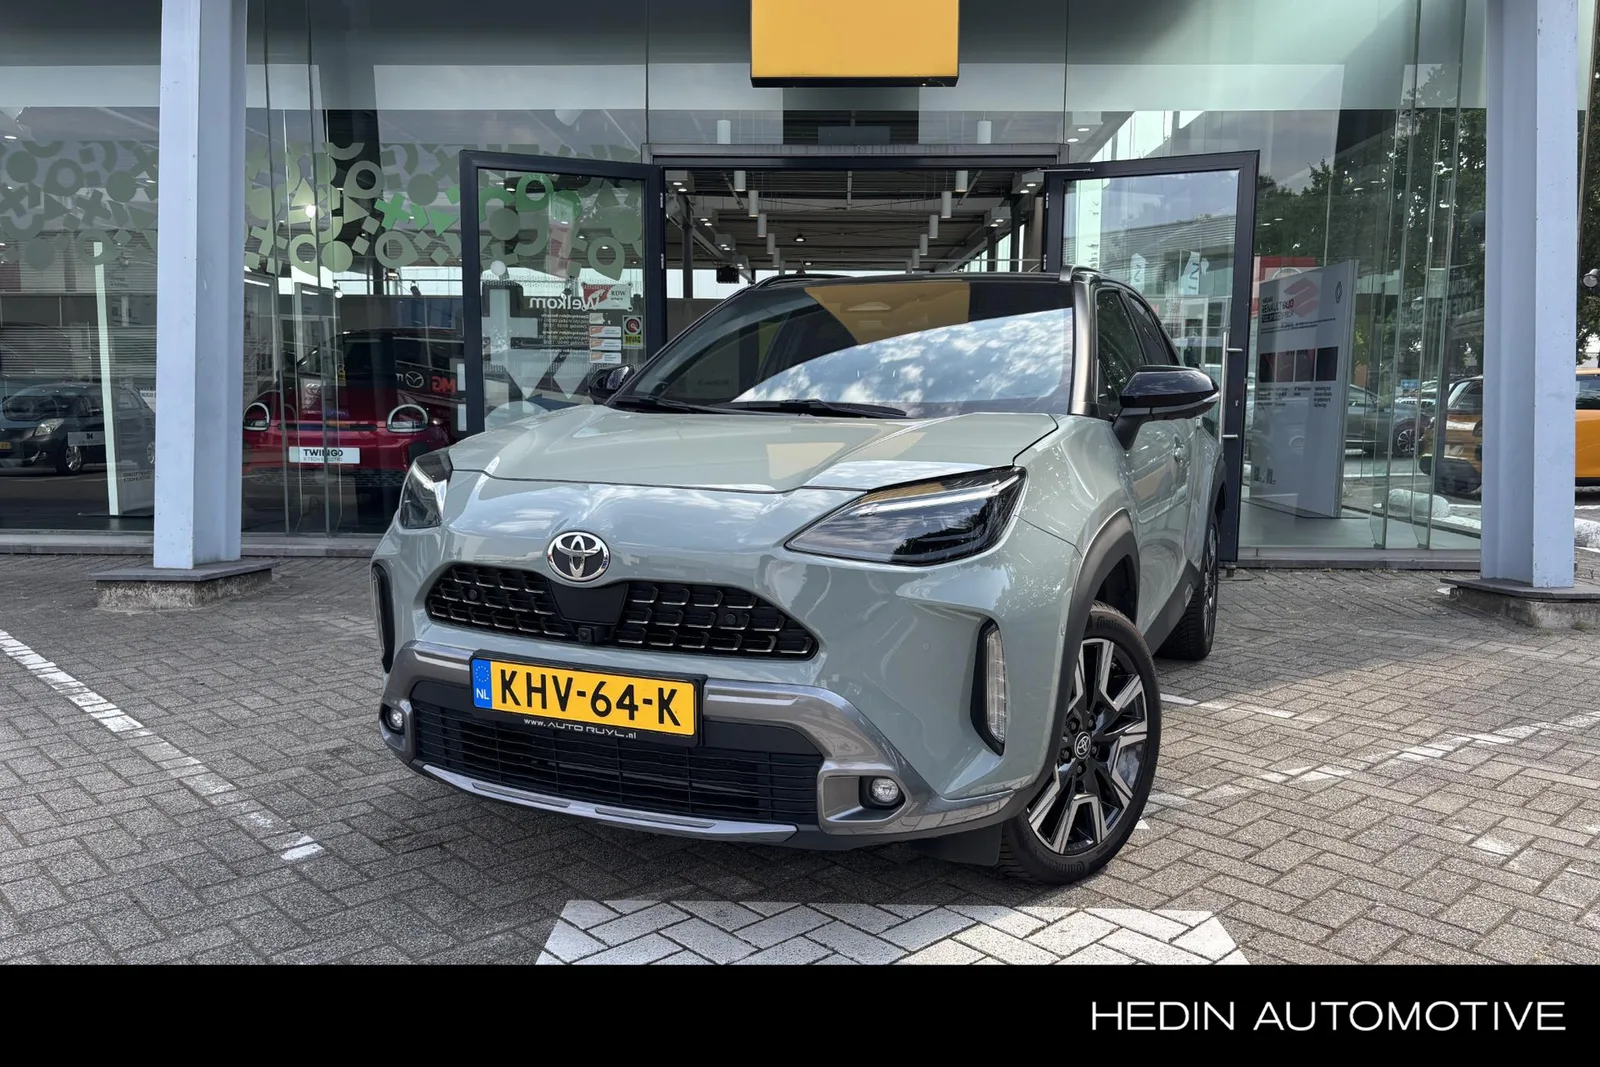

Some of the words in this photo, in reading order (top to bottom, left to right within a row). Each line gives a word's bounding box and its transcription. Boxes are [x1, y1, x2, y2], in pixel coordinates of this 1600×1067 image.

[303, 448, 343, 457] TWINGO
[476, 688, 490, 701] NL
[500, 669, 681, 727] KHV-64-K
